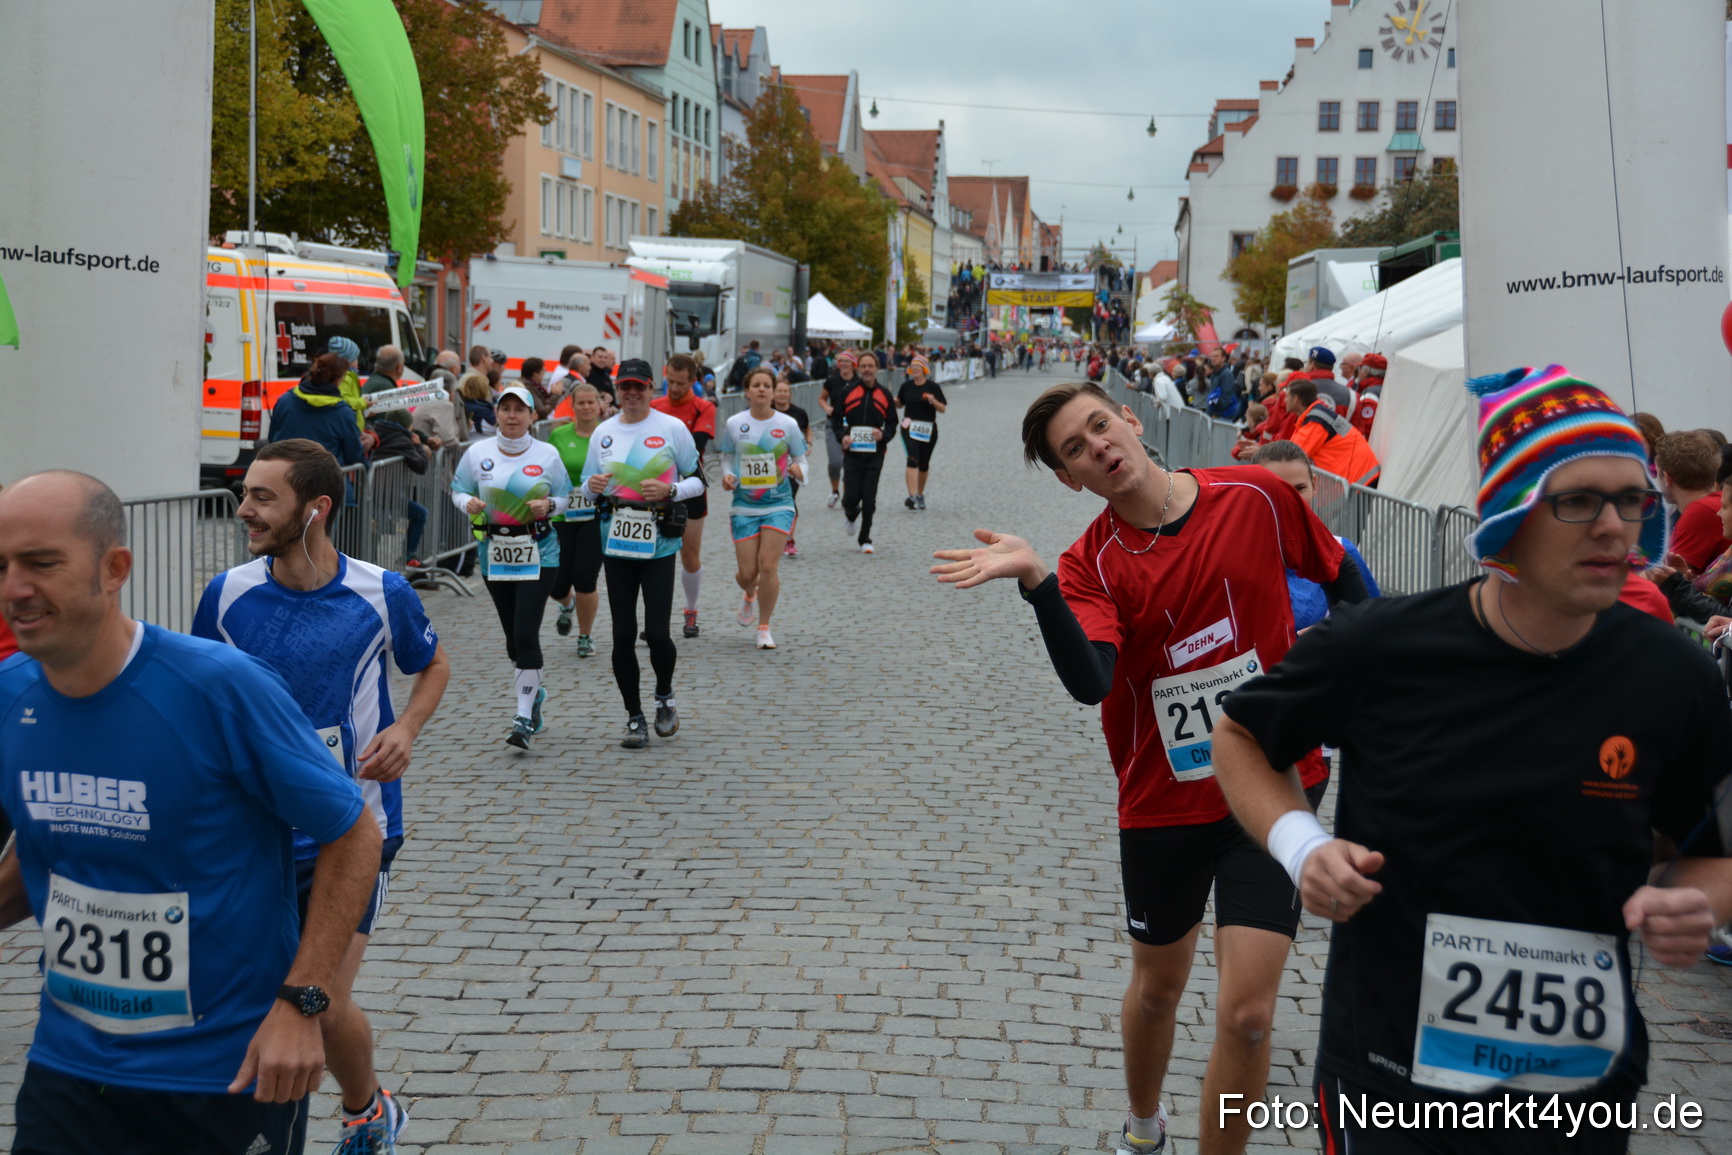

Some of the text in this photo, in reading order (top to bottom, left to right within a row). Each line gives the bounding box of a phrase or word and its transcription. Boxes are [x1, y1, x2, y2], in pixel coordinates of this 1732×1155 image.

[207, 261, 222, 273] G
[1506, 265, 1724, 294] www.bmw-laufsport.de
[539, 302, 590, 312] Bayerisches
[1021, 294, 1057, 304] START
[539, 312, 563, 321] Rotes
[538, 323, 563, 332] Kreuz
[852, 432, 874, 443] 2563
[911, 423, 930, 434] 2459
[747, 462, 769, 476] 184
[613, 520, 652, 540] 3026
[493, 546, 534, 563] 3027
[1187, 632, 1215, 654] DEHN
[1154, 669, 1244, 700] PARTL Neumarkt
[20, 770, 149, 813] HUBER
[48, 805, 143, 827] TECHNOLOGY
[50, 823, 147, 842] WASTE WATER Solutions
[52, 889, 158, 923] PARTL Neumarkt
[55, 915, 173, 983] 2318
[1431, 931, 1587, 967] PARTL Neumarkt
[69, 982, 154, 1015] Willibald
[1441, 960, 1607, 1041] 2458
[1367, 1052, 1408, 1078] SPIRO
